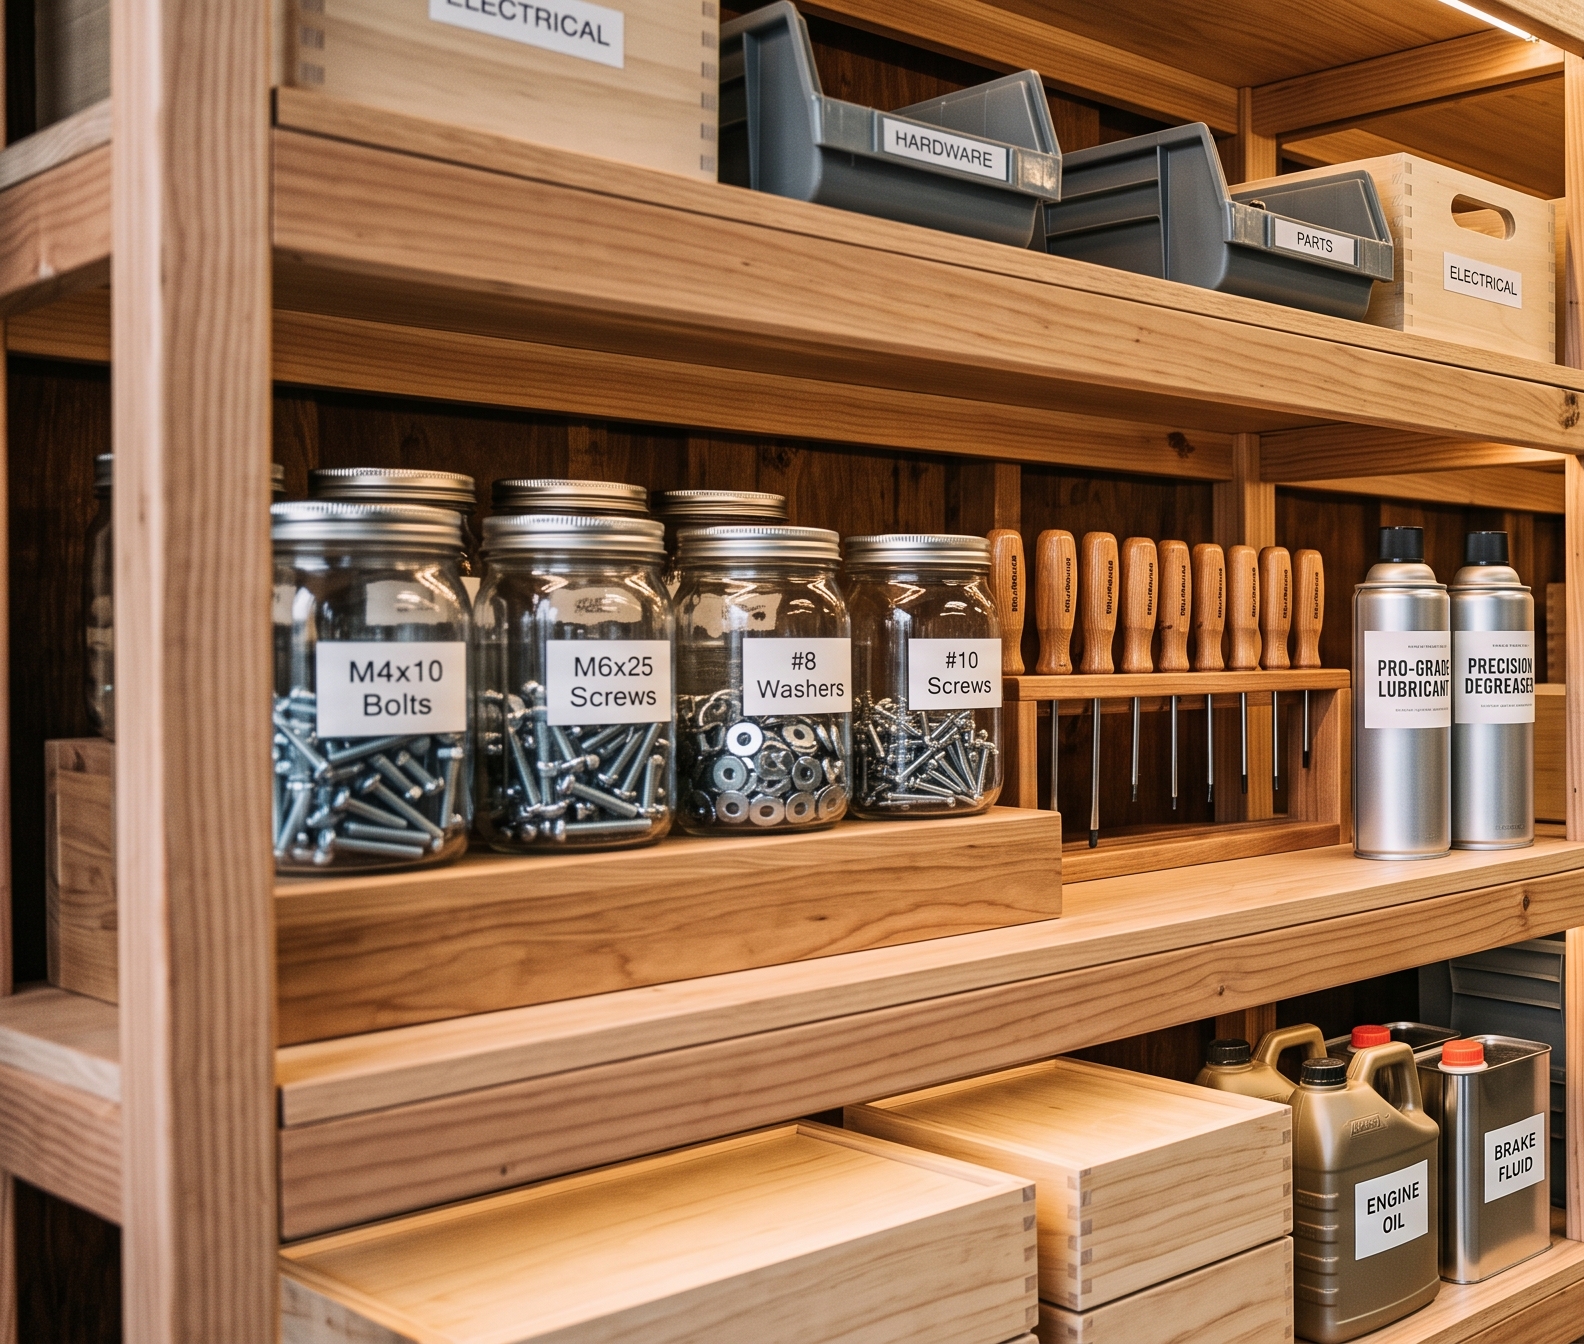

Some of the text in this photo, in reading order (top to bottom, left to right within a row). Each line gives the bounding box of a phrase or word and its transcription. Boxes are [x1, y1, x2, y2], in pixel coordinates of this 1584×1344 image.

[445, 0, 611, 47] ECTRICAL
[895, 130, 993, 169] HARDWARE
[1297, 231, 1333, 253] PARTS
[1450, 265, 1518, 296] ELECTRICAL
[574, 656, 653, 677] M6x25
[791, 651, 817, 671] #8
[945, 651, 979, 669] #10
[1468, 657, 1533, 675] PRECISION
[349, 660, 443, 683] M4x10
[757, 679, 845, 698] Washers
[928, 676, 992, 695] Screws
[1378, 680, 1450, 698] LUBRICANT
[363, 693, 432, 716] Bolts
[570, 686, 657, 708] Screws
[1494, 1132, 1536, 1161] BRAKE
[1499, 1156, 1533, 1182] FLUID
[1367, 1181, 1420, 1215] ENGINE
[1382, 1212, 1405, 1234] OIL
